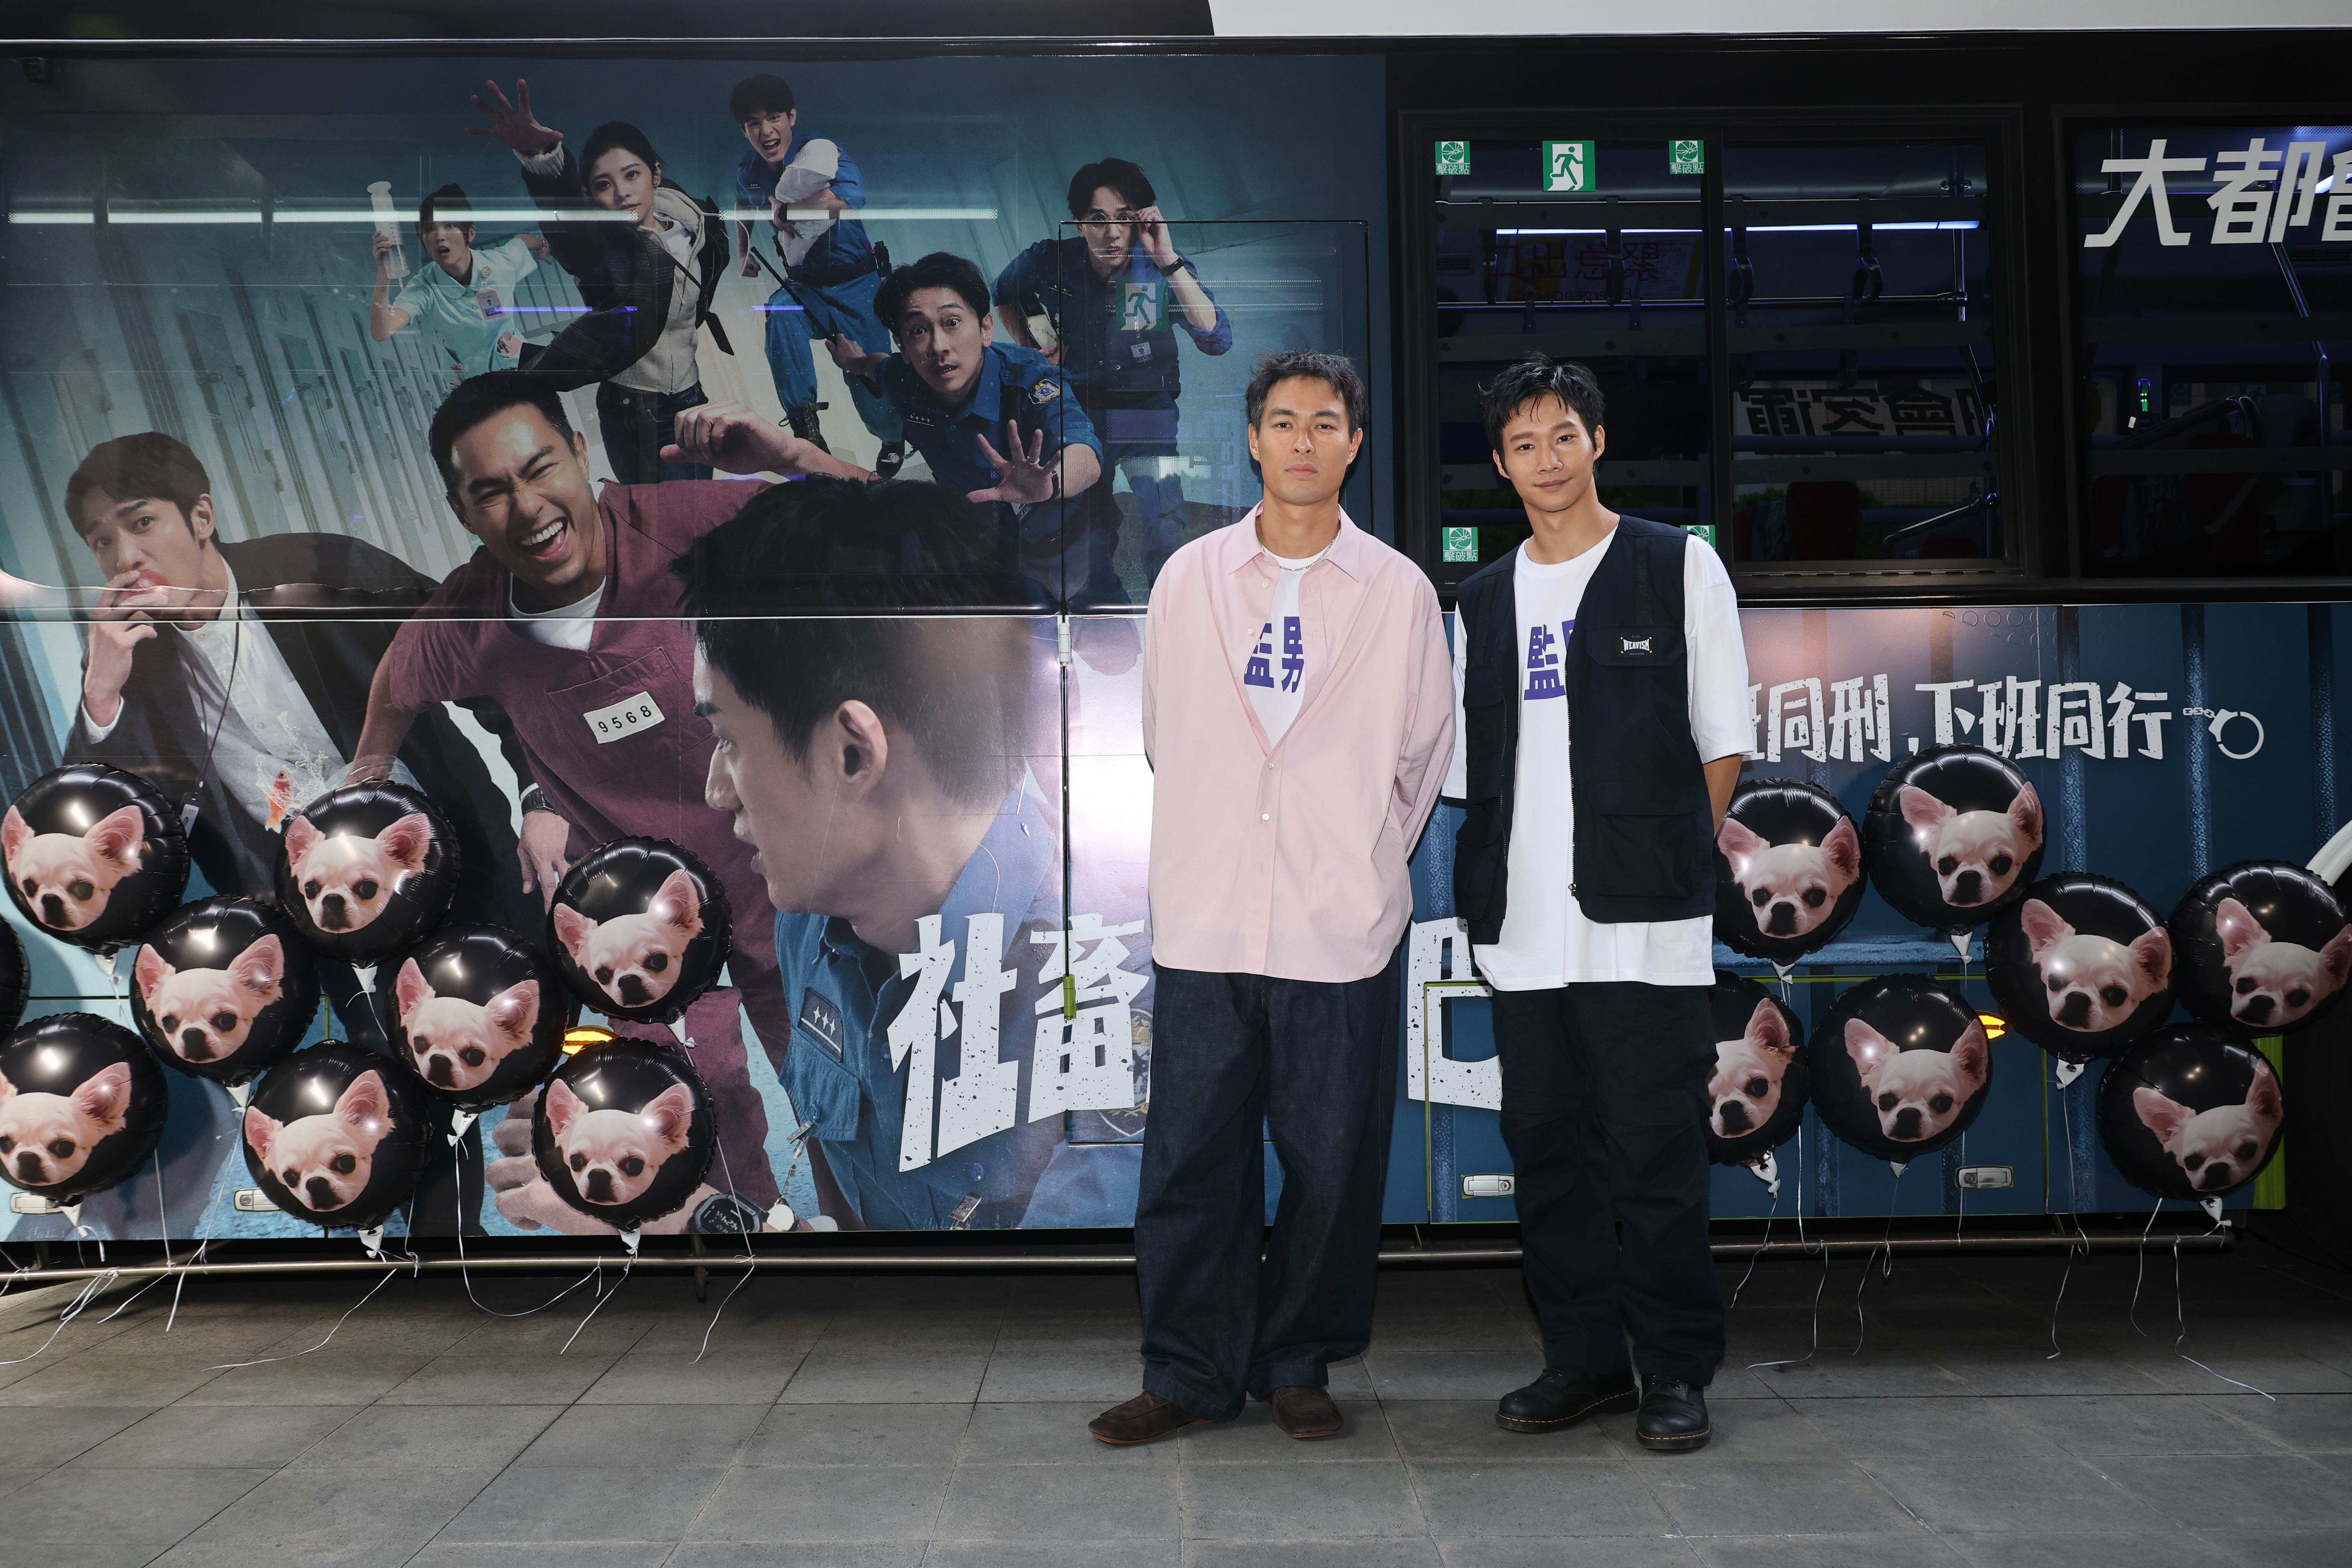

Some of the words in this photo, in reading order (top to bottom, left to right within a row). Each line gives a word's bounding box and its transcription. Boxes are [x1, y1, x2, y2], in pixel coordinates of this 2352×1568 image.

[1437, 164, 1469, 175] 擊破點
[1671, 163, 1703, 174] 擊破點
[1445, 551, 1477, 562] 擊破點
[1623, 639, 1650, 651] WEAVISM
[1524, 619, 1575, 701] 監
[598, 706, 652, 733] 9568
